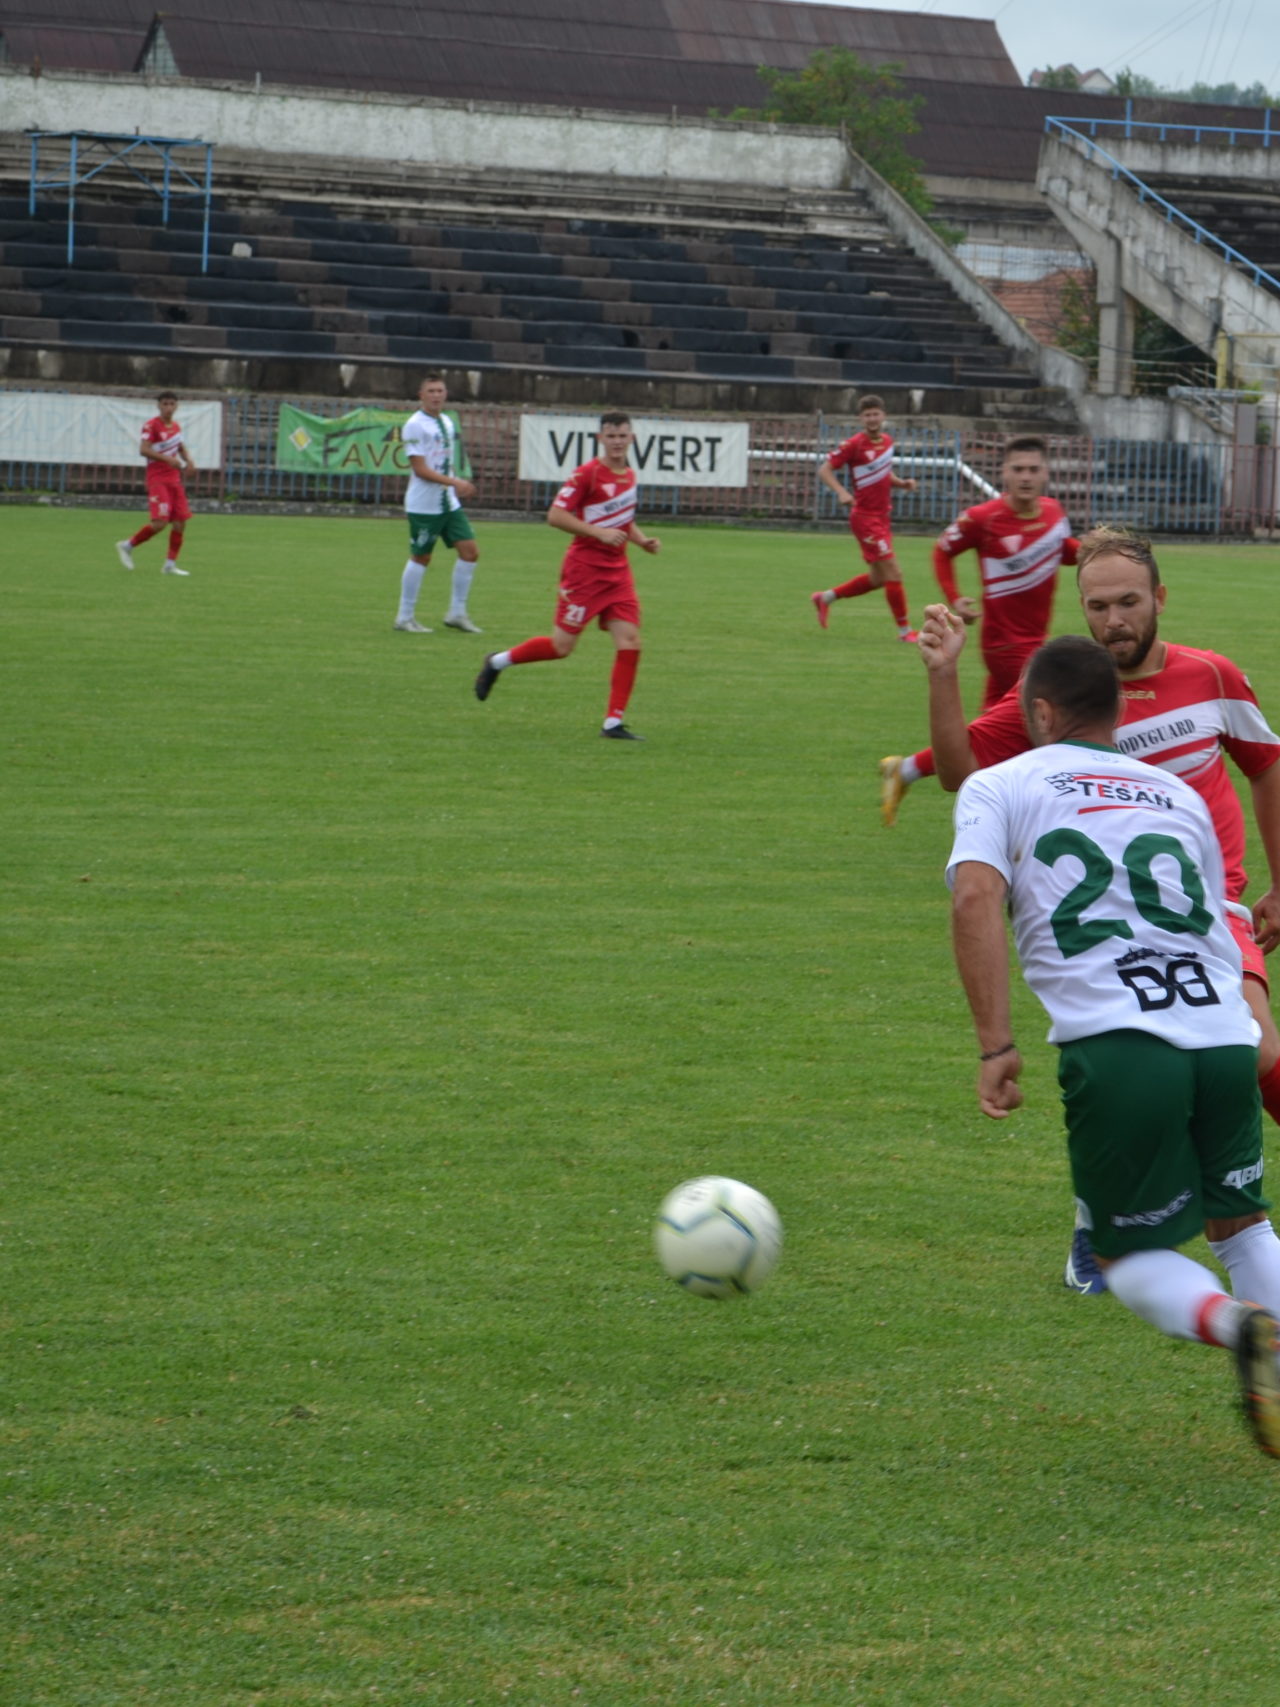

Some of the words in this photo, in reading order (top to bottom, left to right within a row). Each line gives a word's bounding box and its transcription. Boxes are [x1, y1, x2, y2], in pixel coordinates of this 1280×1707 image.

[548, 430, 722, 472] VITVERT
[564, 604, 587, 624] 21
[1114, 718, 1196, 755] ODYGUARD
[1033, 827, 1215, 960] 20
